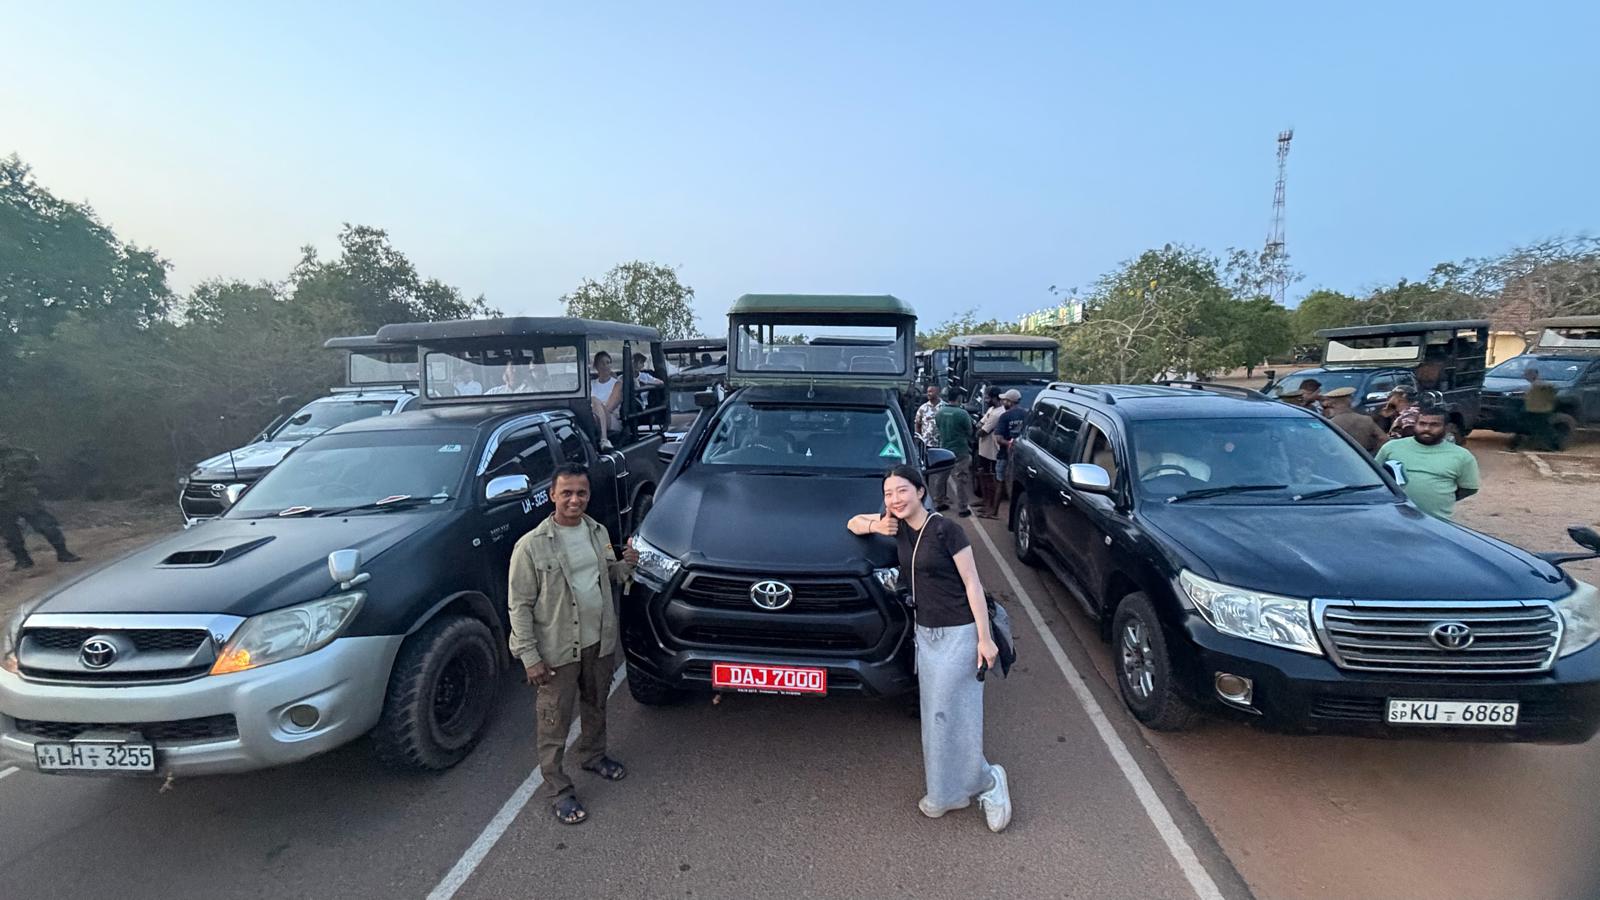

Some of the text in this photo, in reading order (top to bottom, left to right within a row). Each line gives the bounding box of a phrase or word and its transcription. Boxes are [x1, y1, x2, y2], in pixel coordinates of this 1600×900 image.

[730, 667, 820, 689] DAJ 7000
[1390, 710, 1407, 721] SP
[1410, 703, 1438, 721] KU
[1461, 704, 1515, 722] 6868
[57, 747, 84, 766] LH
[104, 747, 152, 767] 3255
